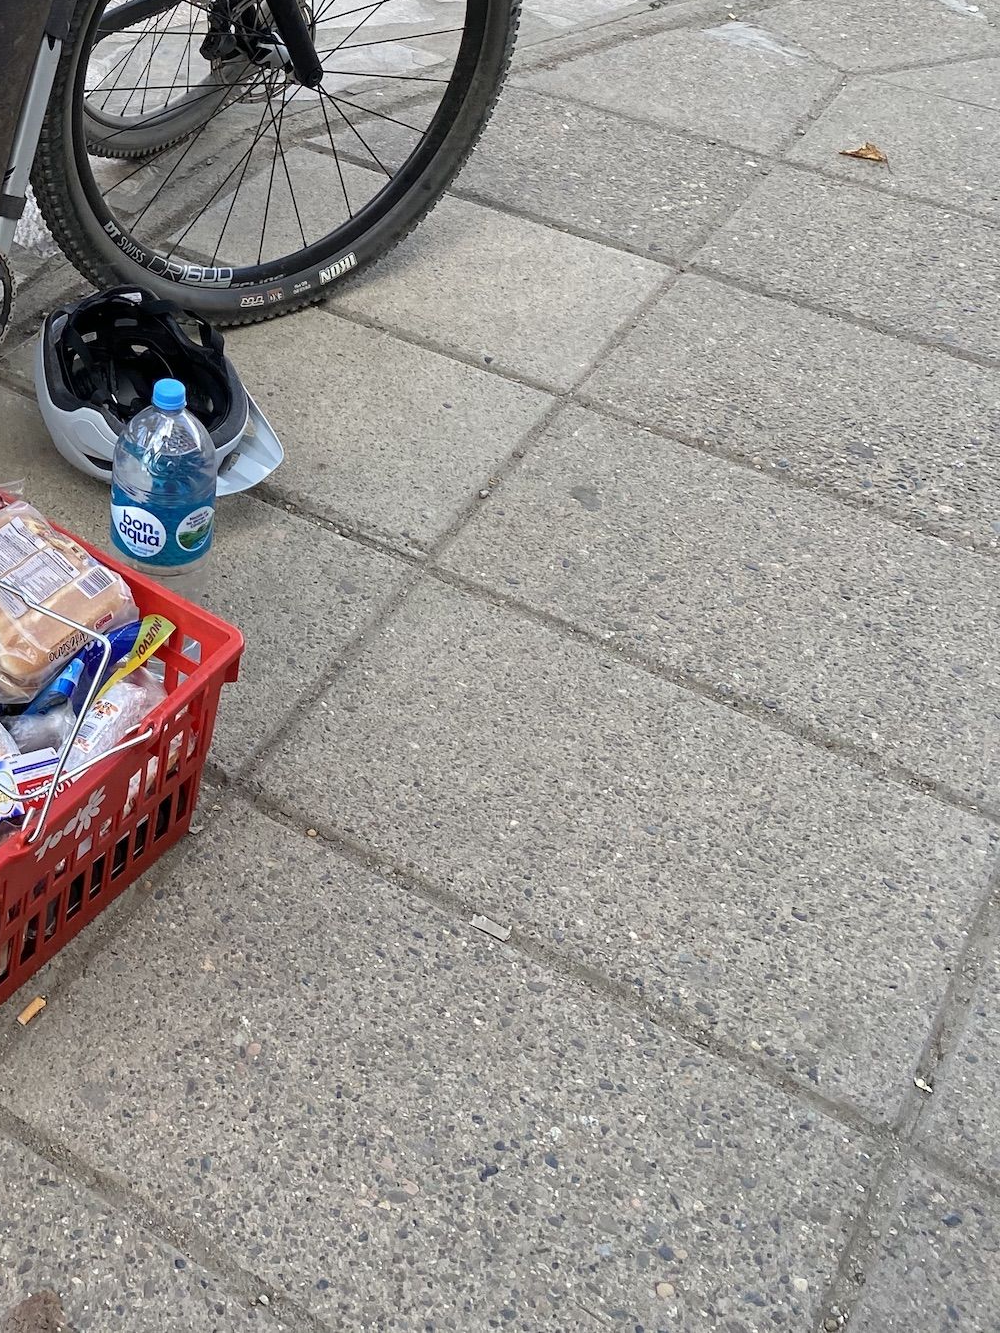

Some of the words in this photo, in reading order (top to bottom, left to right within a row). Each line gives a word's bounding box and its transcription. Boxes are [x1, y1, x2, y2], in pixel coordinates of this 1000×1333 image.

[103, 221, 122, 240] DT
[117, 236, 146, 264] SWISS
[318, 252, 358, 286] IKON
[119, 522, 160, 547] aqua
[123, 509, 154, 535] bon
